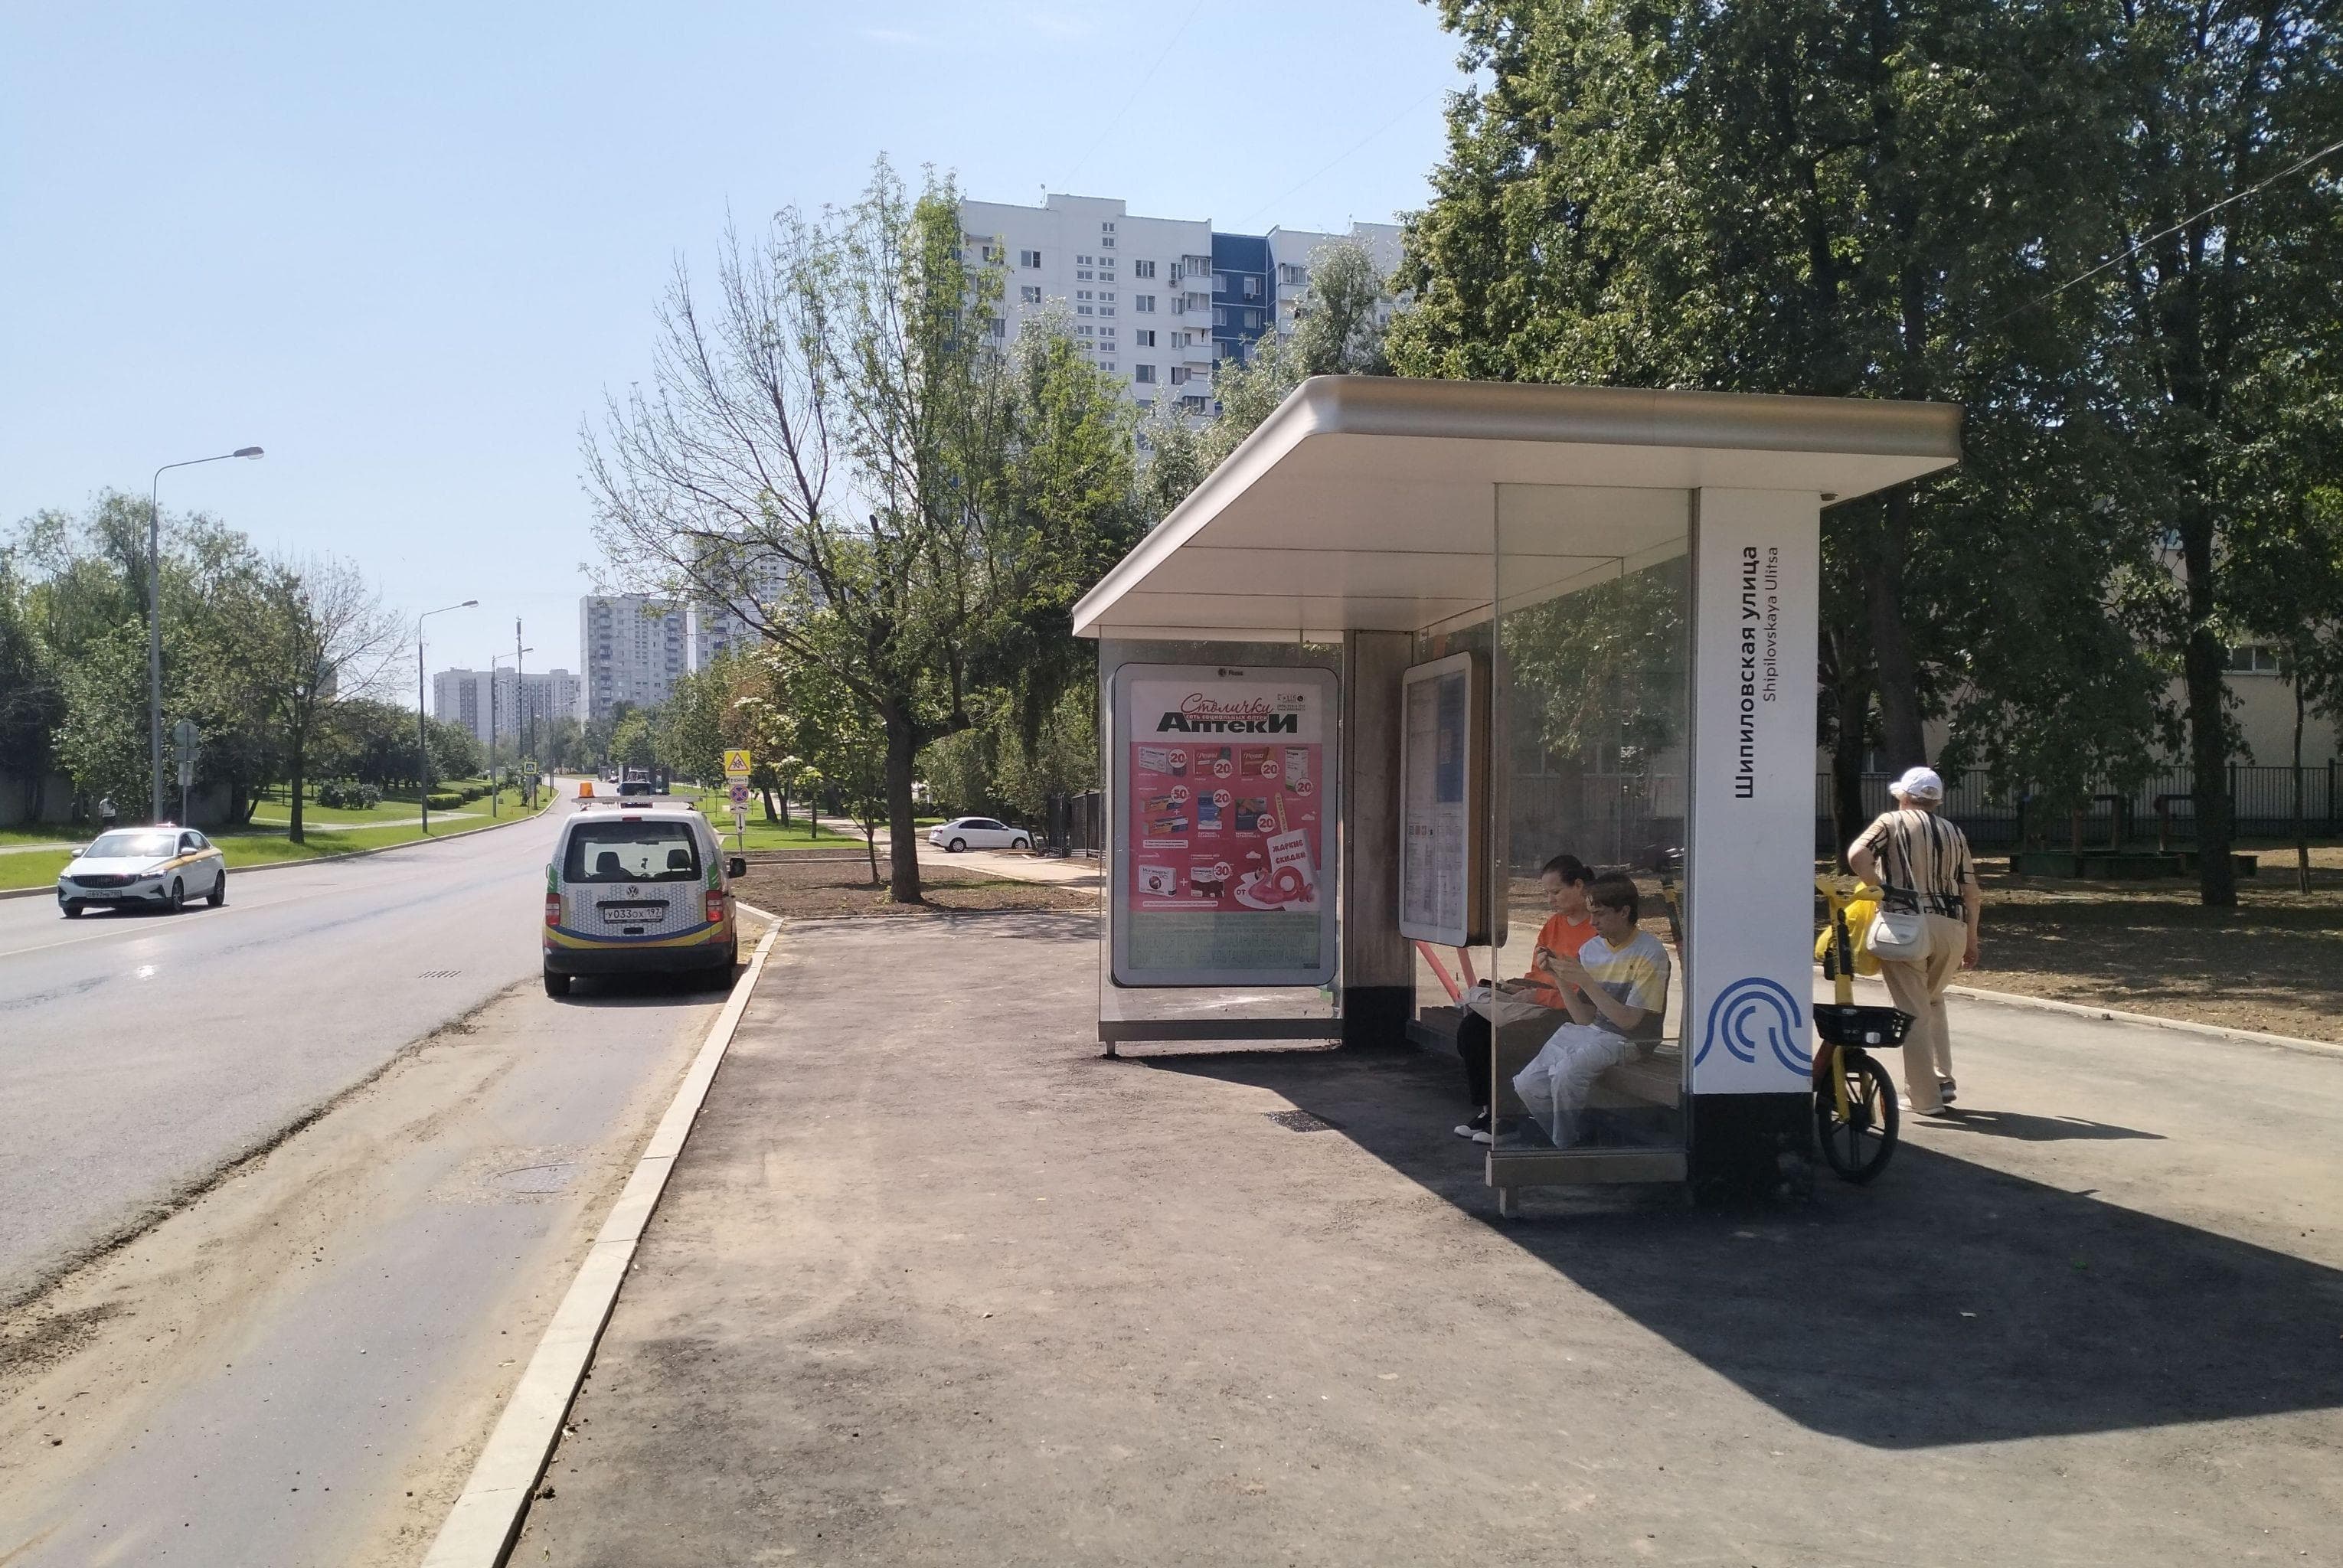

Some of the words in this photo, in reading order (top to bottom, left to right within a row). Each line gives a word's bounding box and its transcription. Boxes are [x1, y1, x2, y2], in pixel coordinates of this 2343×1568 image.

[1742, 546, 1760, 620] улица
[1764, 547, 1778, 590] Ulitsa
[1763, 596, 1780, 702] Shipilovskaya
[1180, 693, 1274, 714] Столички
[1735, 628, 1756, 798] Шипиловская
